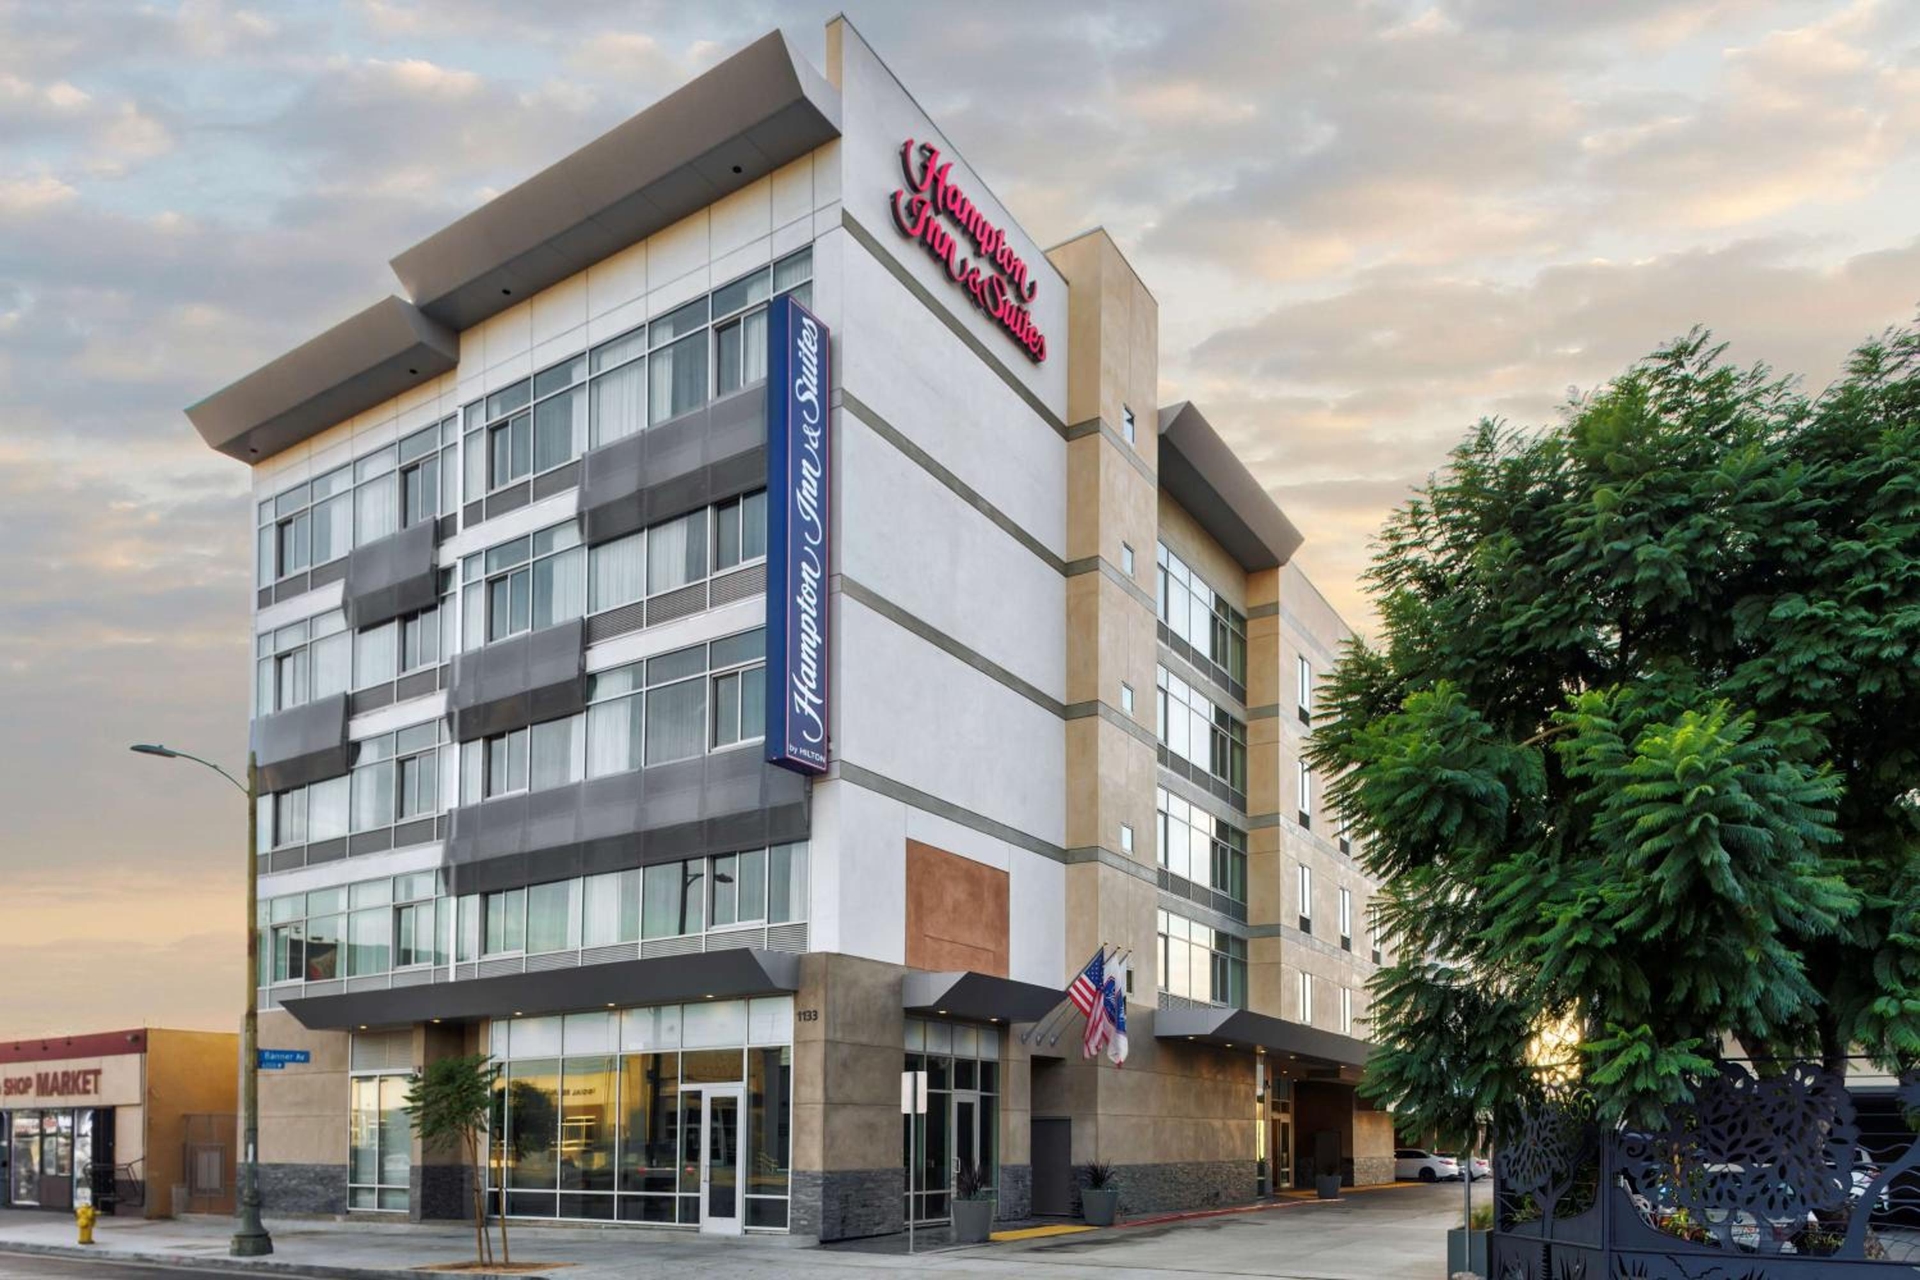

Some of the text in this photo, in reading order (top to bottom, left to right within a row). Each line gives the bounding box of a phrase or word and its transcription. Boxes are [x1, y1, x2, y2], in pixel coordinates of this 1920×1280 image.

[899, 138, 1038, 303] Hampton
[891, 188, 969, 283] Inn
[983, 272, 1047, 363] Suites
[792, 316, 824, 743] Hampton Inn & Suites
[789, 742, 826, 763] by HILTON
[797, 1009, 819, 1022] 1133
[4, 1076, 33, 1096] SHOP
[36, 1068, 102, 1097] MARKET
